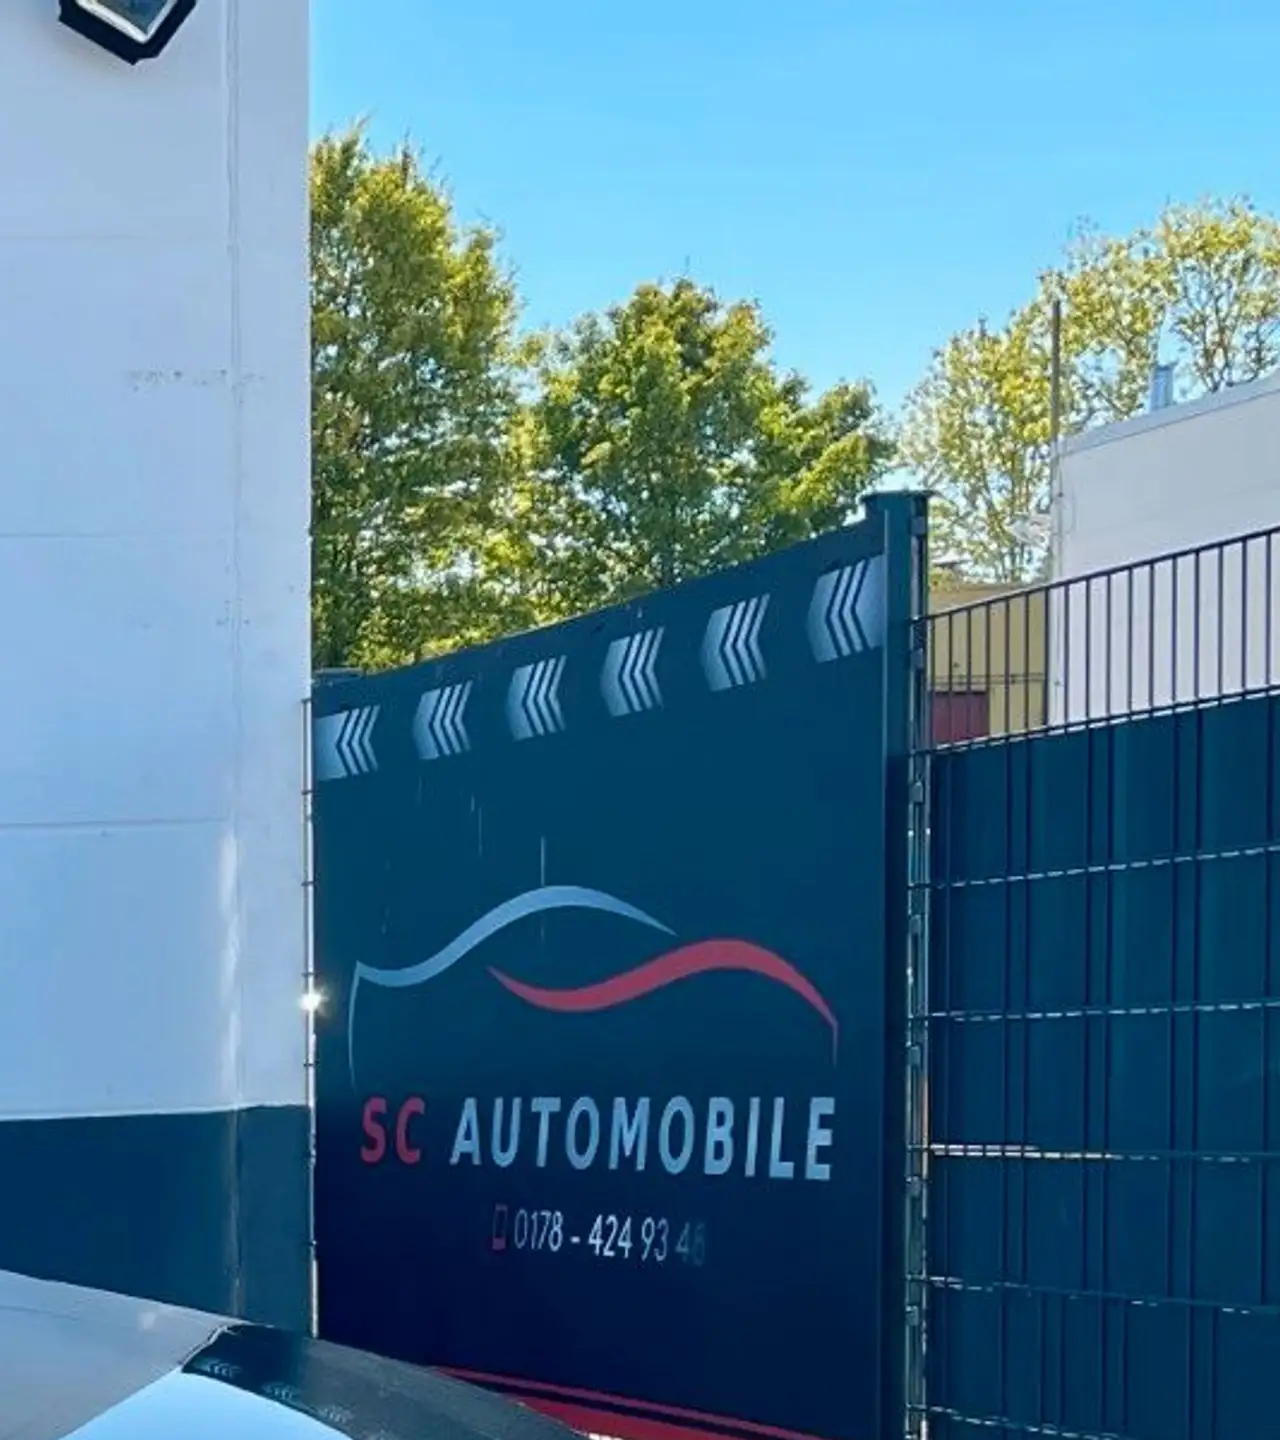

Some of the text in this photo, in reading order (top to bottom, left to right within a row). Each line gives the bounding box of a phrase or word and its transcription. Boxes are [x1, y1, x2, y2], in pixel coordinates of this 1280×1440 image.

[360, 1097, 836, 1181] SC AUTOMOBILE
[514, 1208, 564, 1252] 0178
[587, 1213, 633, 1259] 424
[641, 1216, 670, 1262] 93
